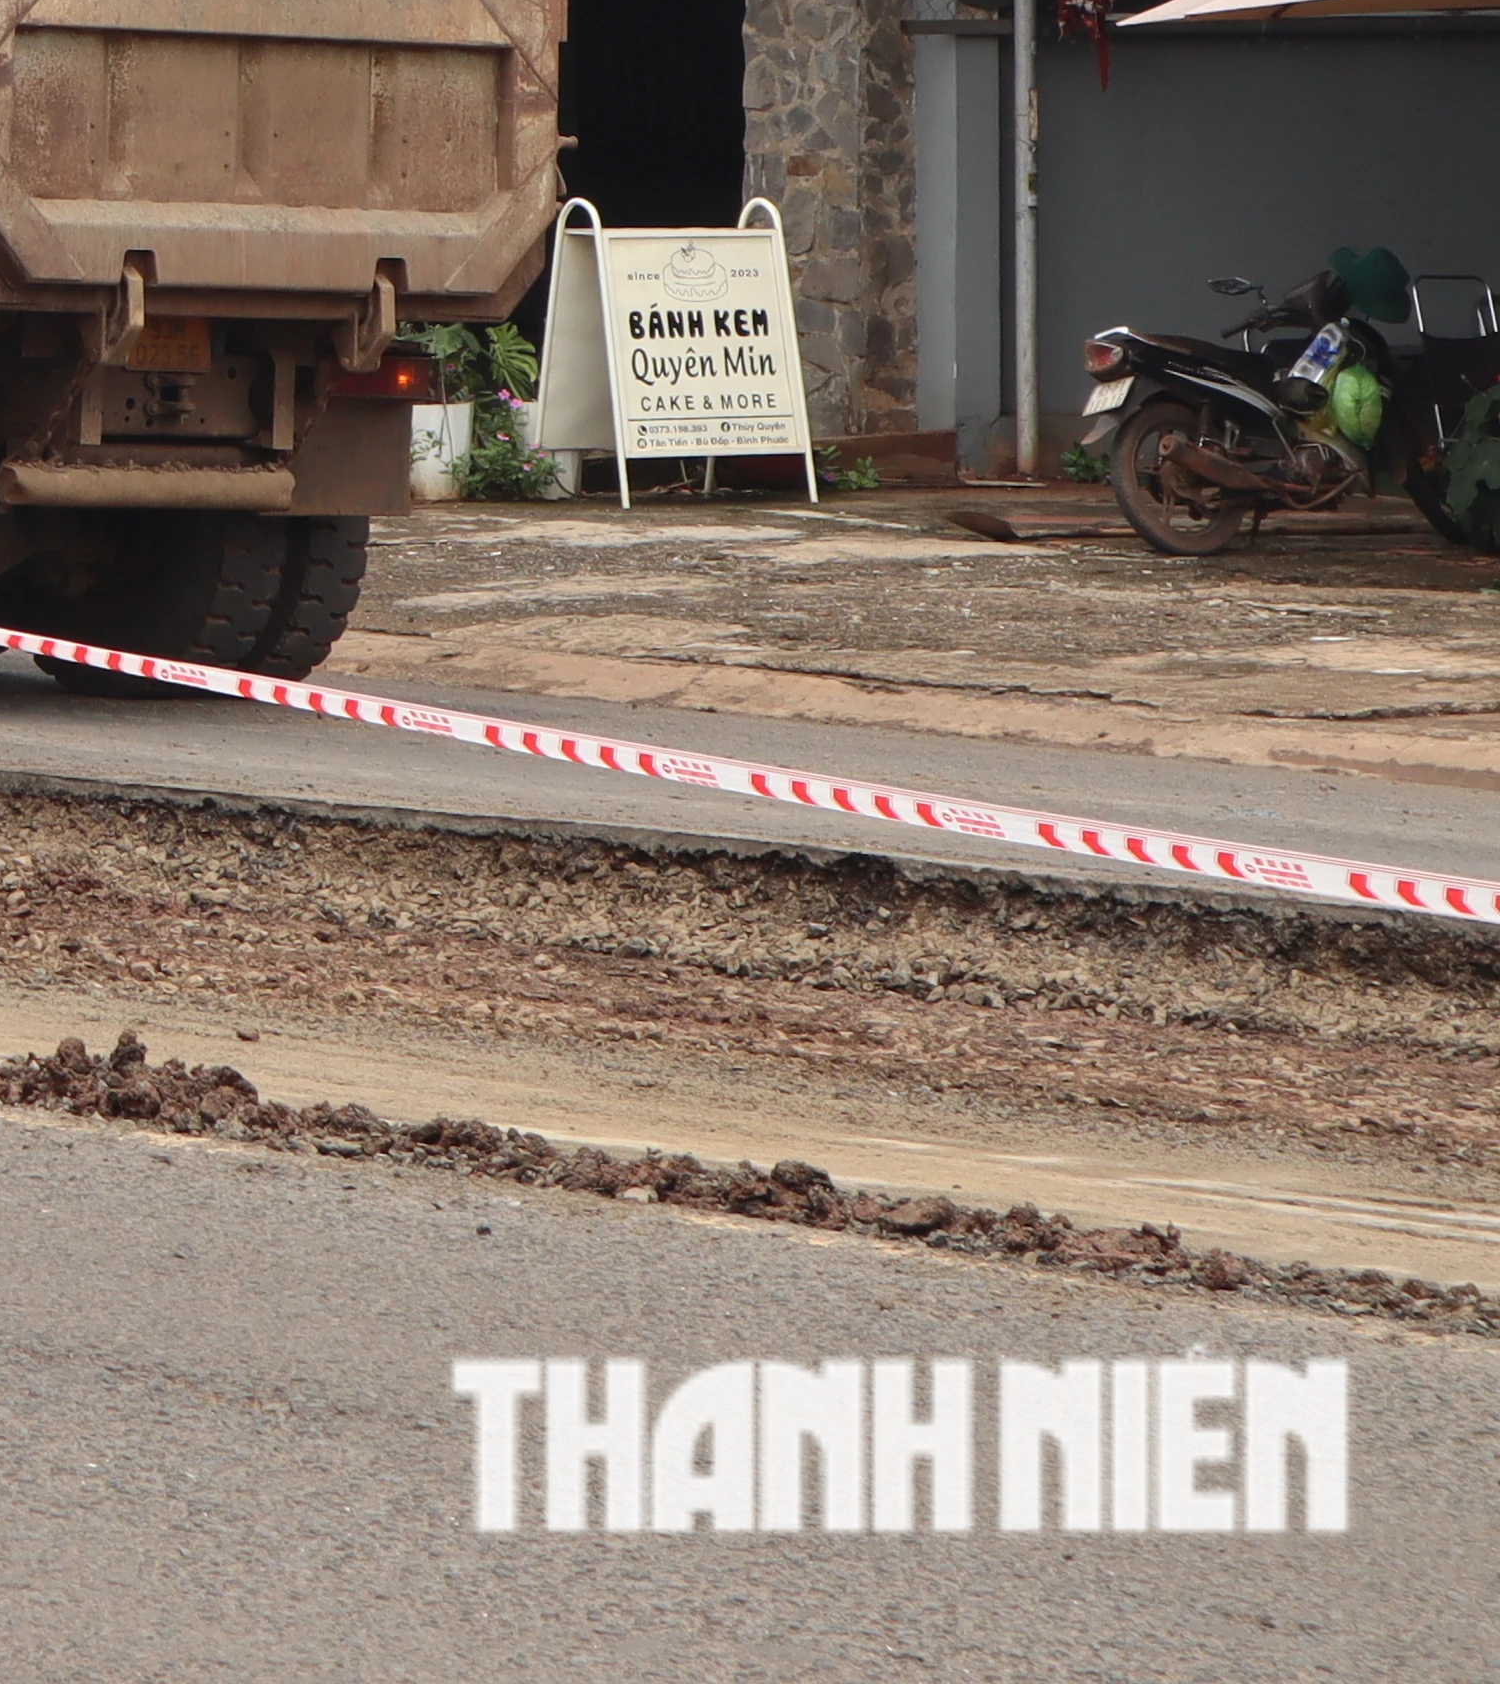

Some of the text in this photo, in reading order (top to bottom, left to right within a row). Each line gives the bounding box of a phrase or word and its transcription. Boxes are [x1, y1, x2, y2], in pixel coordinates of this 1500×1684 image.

[627, 268, 760, 281] since 2023
[628, 303, 769, 340] BÁNH KEM
[631, 345, 777, 386] Quyên Min
[641, 393, 777, 412] CAKE & MORE
